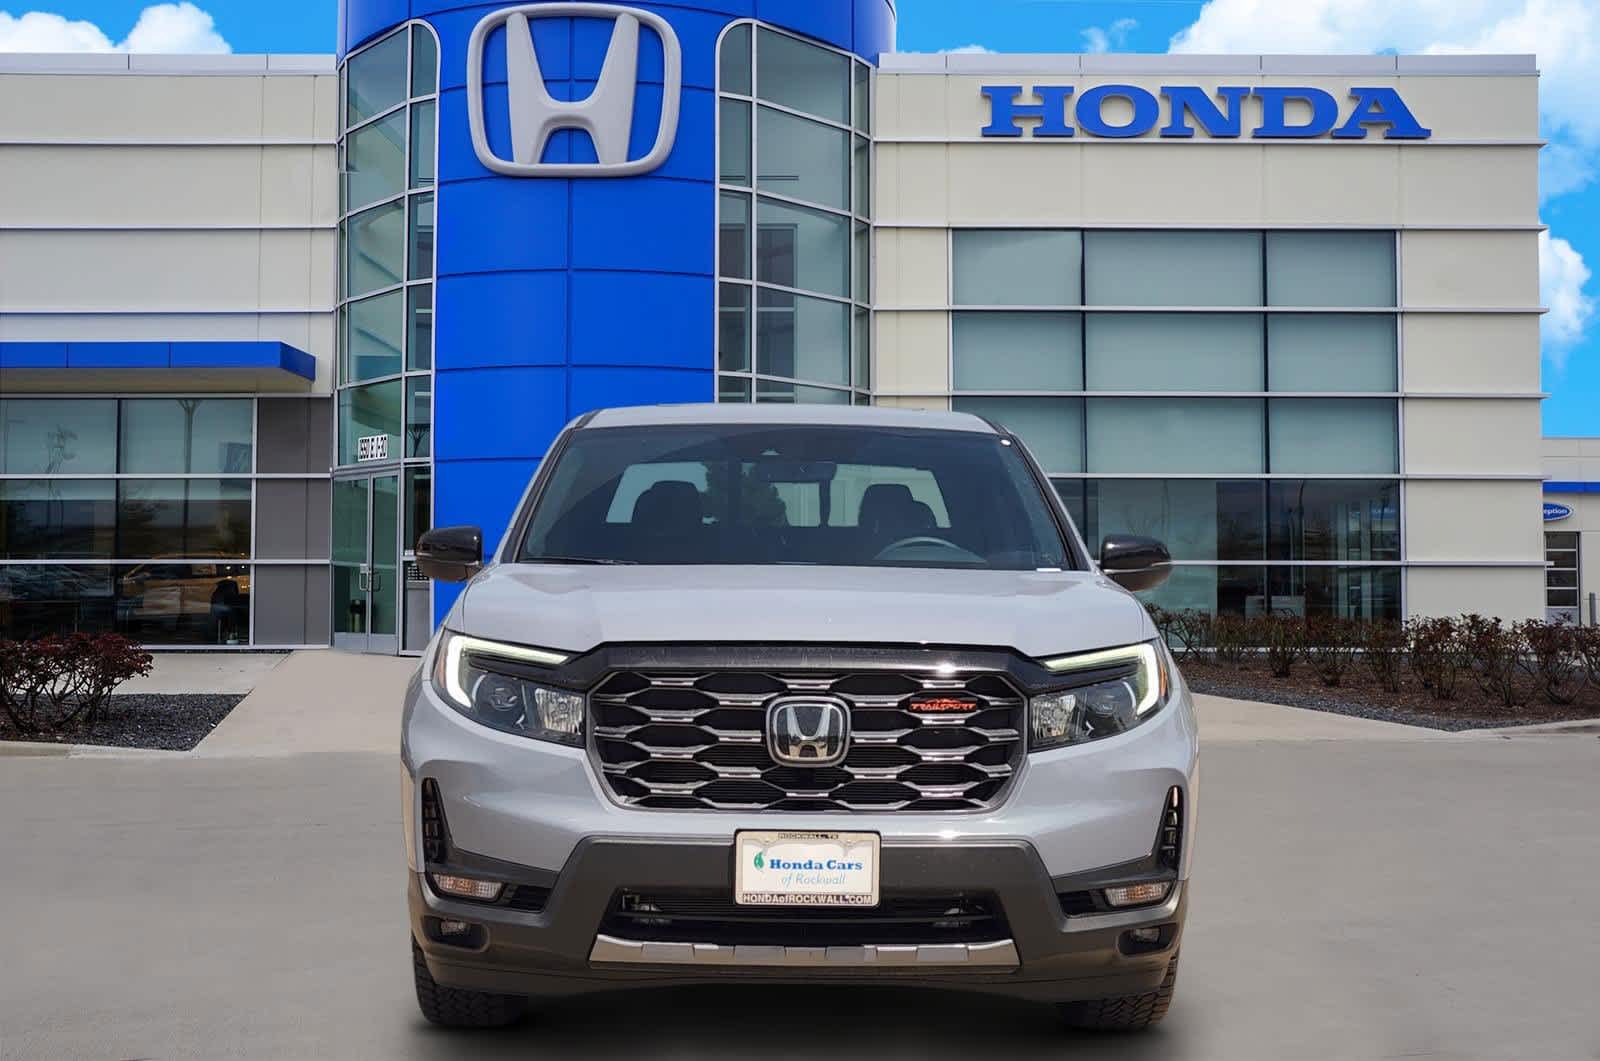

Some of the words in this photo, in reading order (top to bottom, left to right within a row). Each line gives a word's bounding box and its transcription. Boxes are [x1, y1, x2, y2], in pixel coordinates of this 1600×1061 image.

[980, 85, 1432, 139] HONDA
[770, 859, 823, 870] Honda
[827, 859, 863, 870] Cars
[781, 873, 793, 888] of
[795, 873, 846, 885] Rockwall
